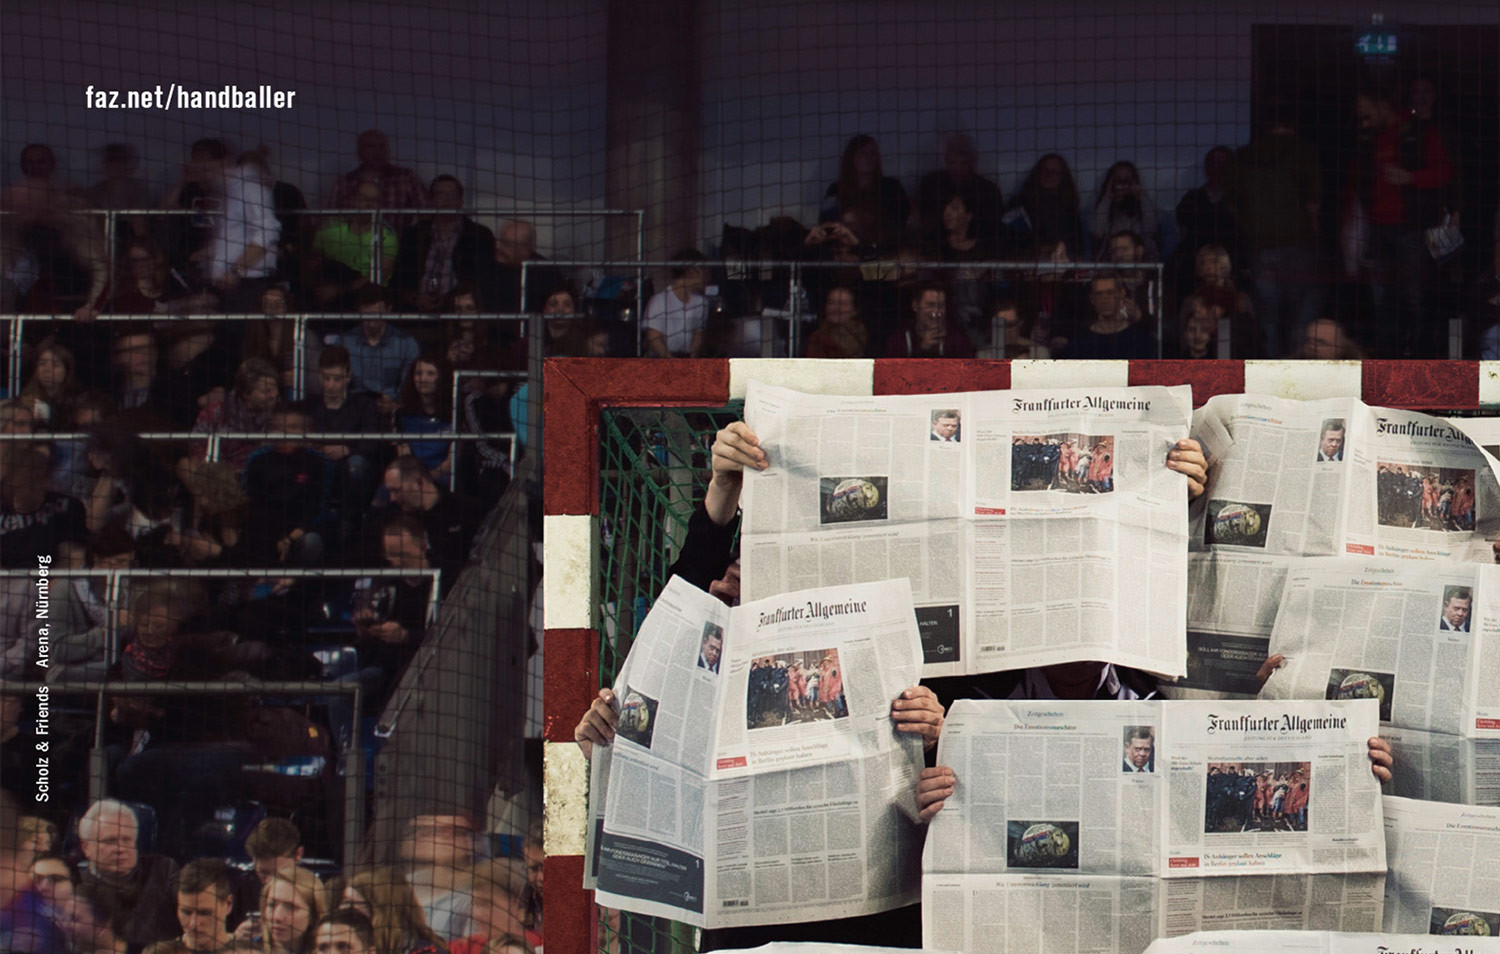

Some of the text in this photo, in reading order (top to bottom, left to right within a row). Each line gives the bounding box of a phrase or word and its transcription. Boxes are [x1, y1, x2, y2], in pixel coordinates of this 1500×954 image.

[1012, 396, 1151, 414] Frankfurter Allgemeine
[1377, 418, 1445, 437] Frankfurter
[1207, 714, 1347, 734] Frankfurter Allgemeine
